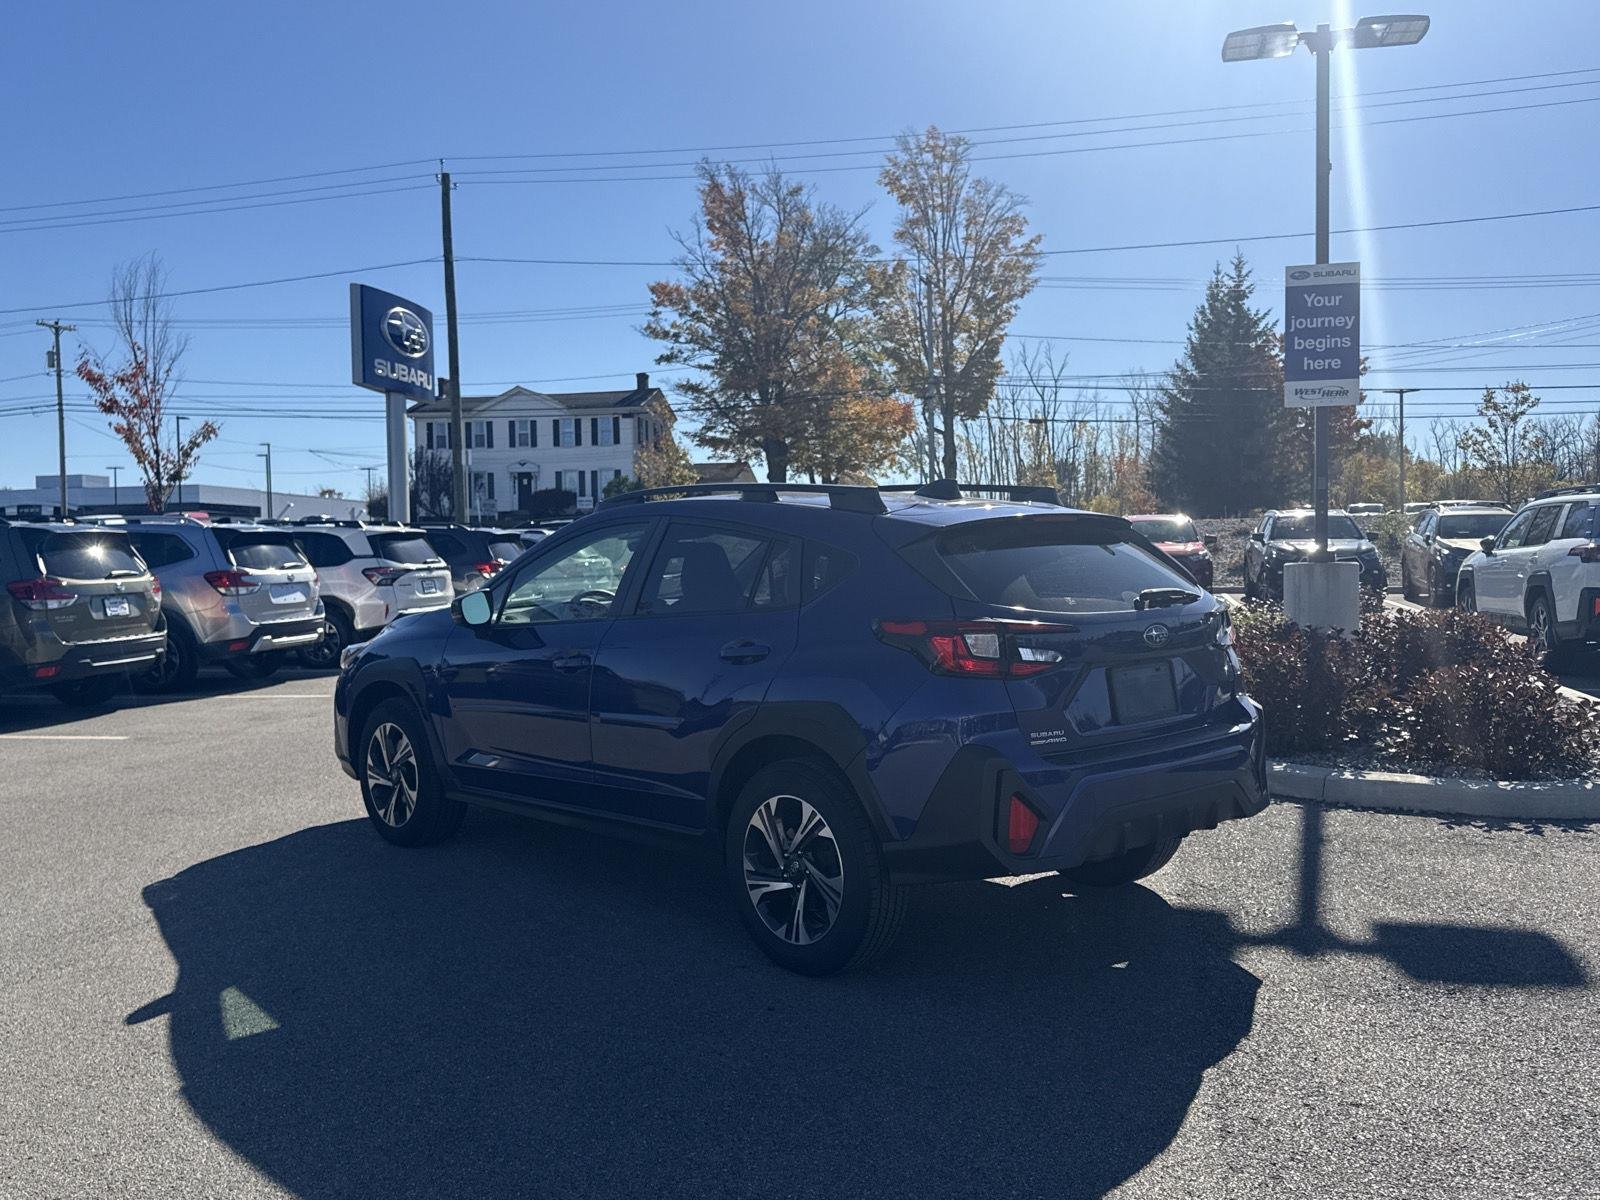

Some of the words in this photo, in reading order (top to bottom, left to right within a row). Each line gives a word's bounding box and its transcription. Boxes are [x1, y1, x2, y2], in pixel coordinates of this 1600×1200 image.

[1313, 269, 1356, 278] SUBARU
[1304, 292, 1343, 308] Your
[1290, 315, 1355, 332] journey
[1294, 335, 1351, 352] begins
[1303, 356, 1342, 371] here
[374, 358, 432, 390] SUBARU
[1030, 730, 1065, 738] SUBARU
